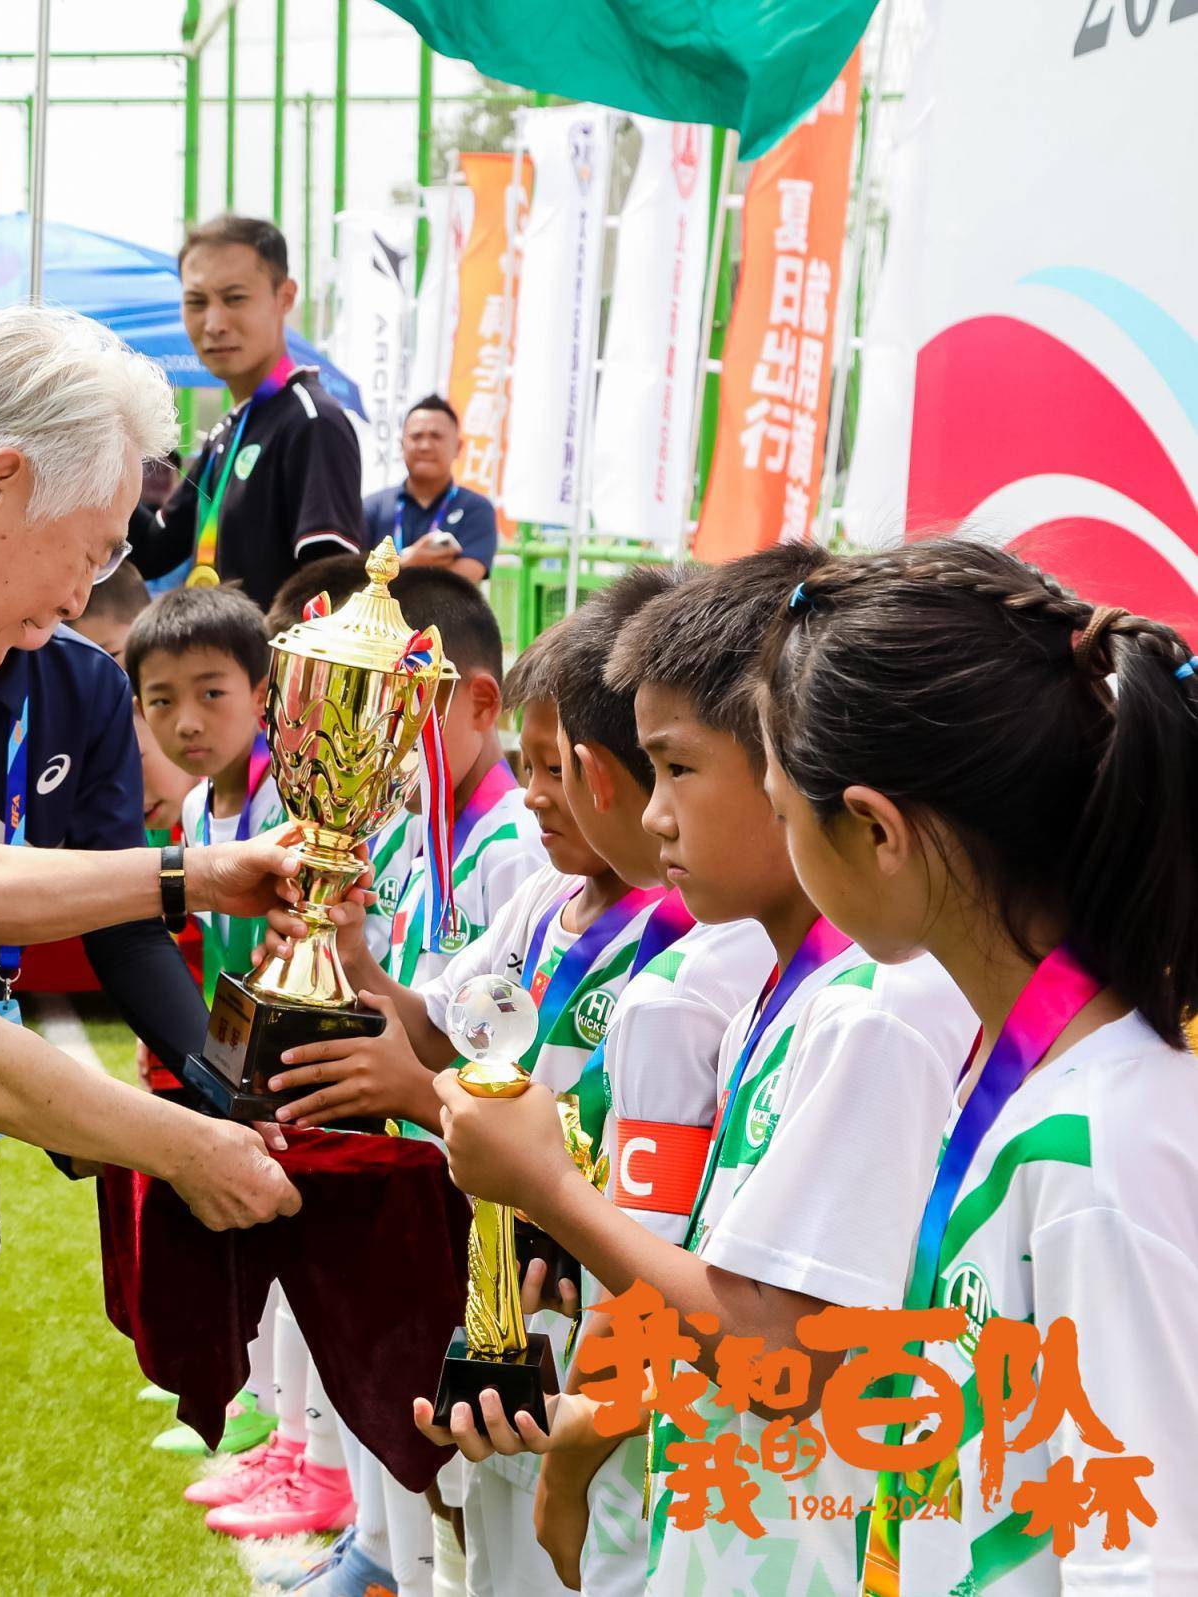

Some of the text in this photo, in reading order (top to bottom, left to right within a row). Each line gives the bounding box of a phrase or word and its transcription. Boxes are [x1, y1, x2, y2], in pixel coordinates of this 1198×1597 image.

[373, 311, 391, 467] ARCFOX
[578, 1013, 608, 1036] KICKE
[619, 1136, 657, 1197] C
